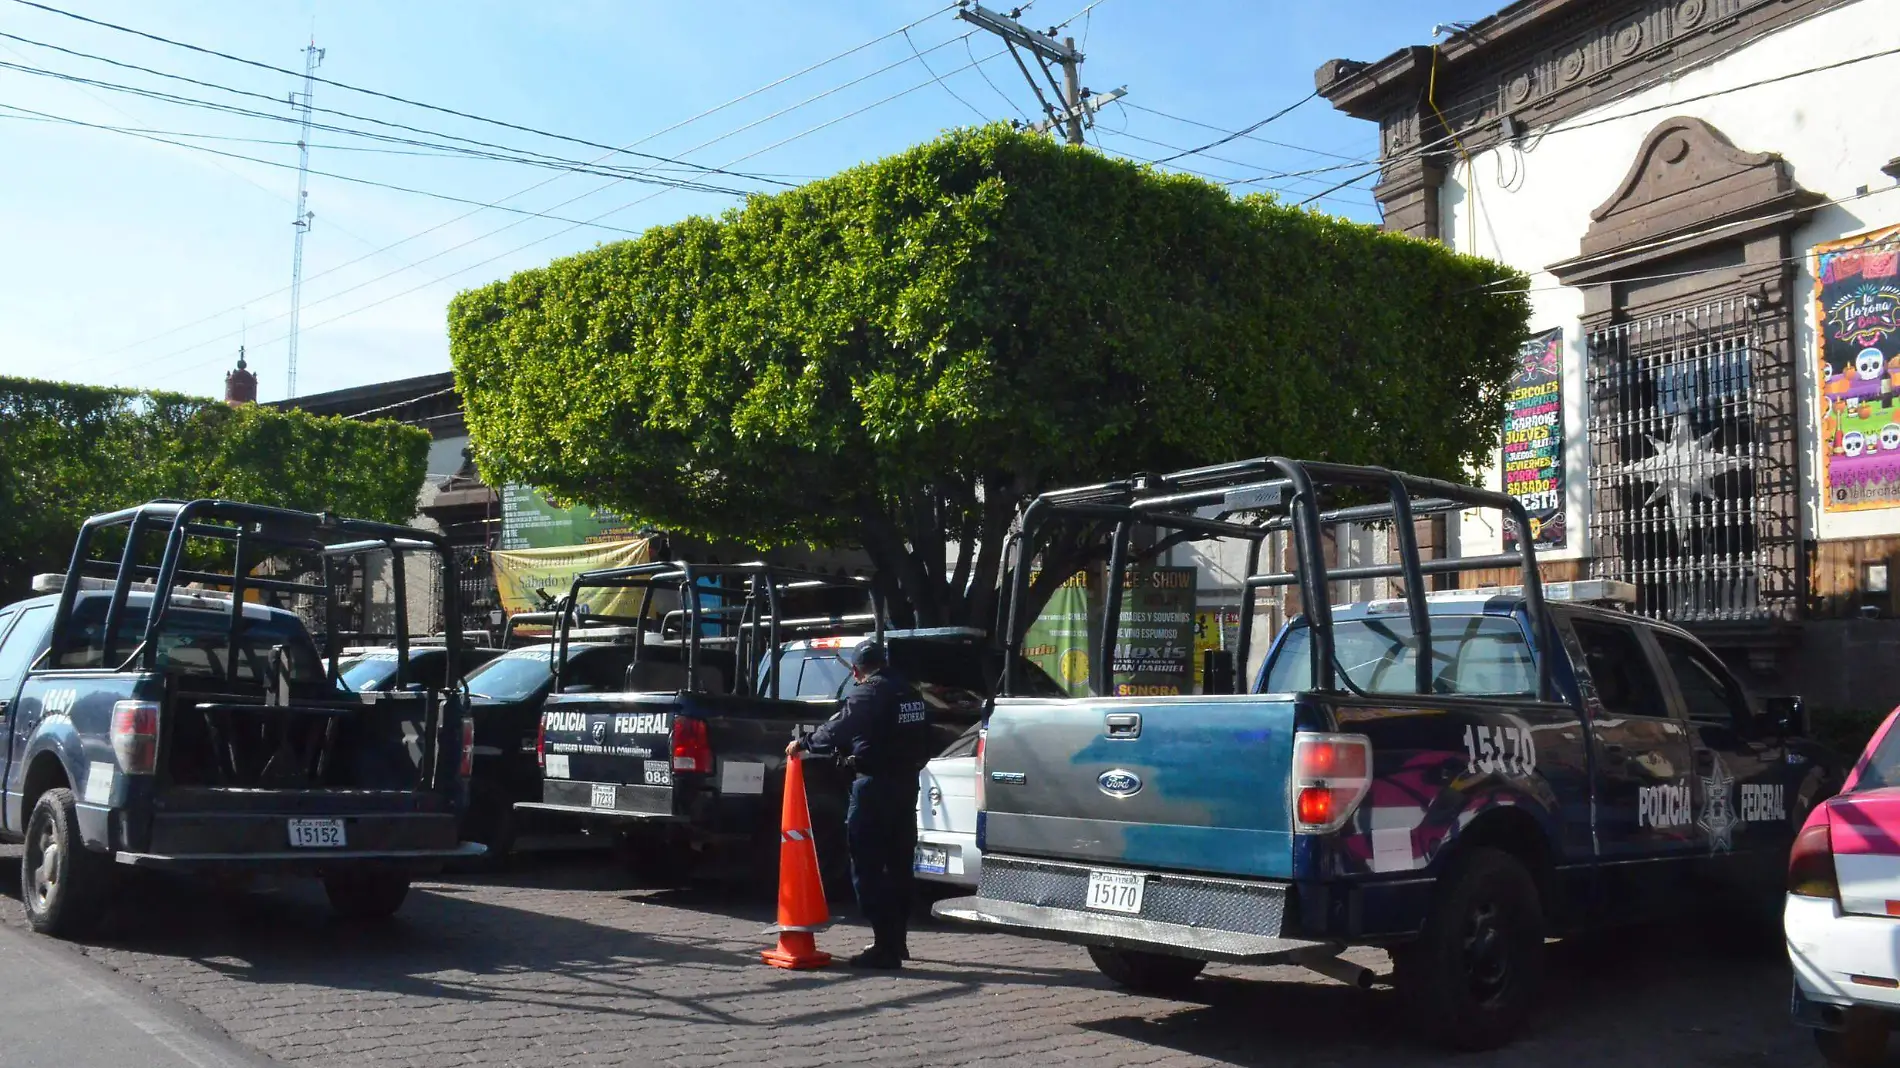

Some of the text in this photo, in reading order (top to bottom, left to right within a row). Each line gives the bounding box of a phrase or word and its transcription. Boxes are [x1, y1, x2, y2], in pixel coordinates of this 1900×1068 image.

[1512, 411, 1558, 431] KARAOKE
[1505, 425, 1548, 445] JUEVES
[518, 572, 557, 589] Sábado
[1153, 572, 1190, 588] SHOW
[1118, 684, 1178, 696] SONORA
[614, 713, 669, 734] FEDERAL
[1463, 724, 1536, 776] 15170
[1106, 774, 1130, 789] Ford
[1639, 778, 1786, 827] POLICÍA FEDERAL
[296, 827, 340, 844] 15152
[1094, 883, 1137, 908] 15170
